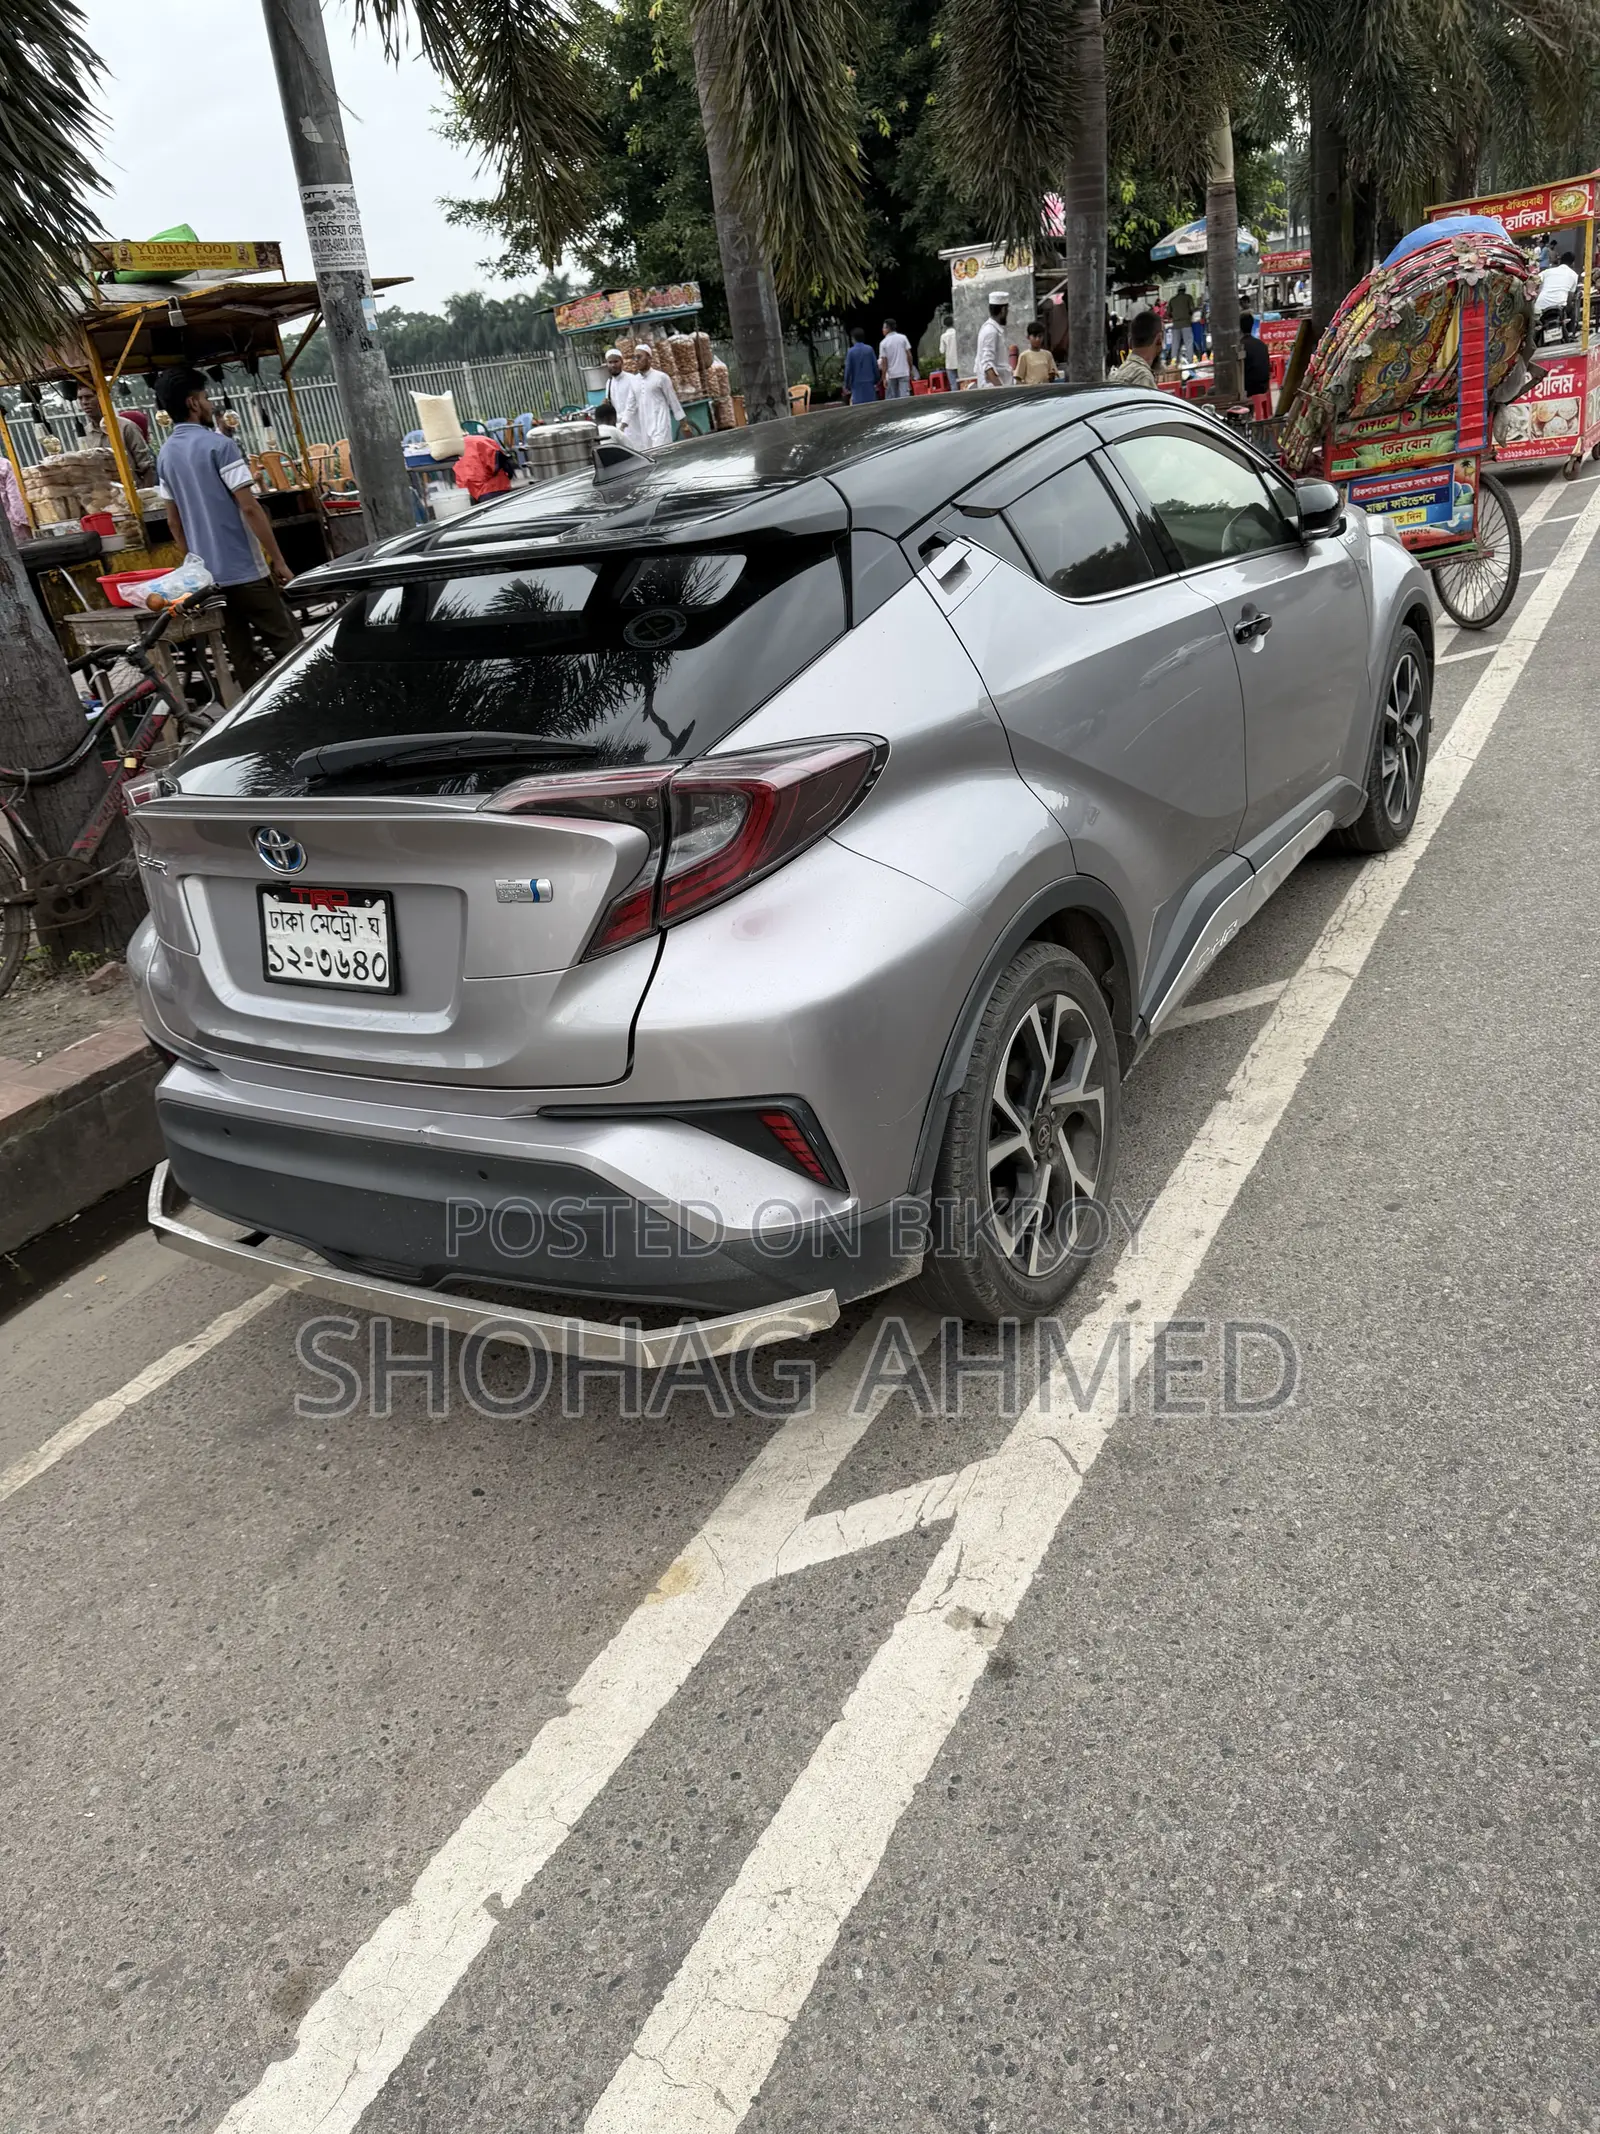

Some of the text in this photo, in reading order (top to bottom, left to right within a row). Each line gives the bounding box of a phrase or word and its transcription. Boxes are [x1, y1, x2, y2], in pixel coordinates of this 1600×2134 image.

[1505, 209, 1547, 231] হালিম
[135, 243, 190, 255] YUMMY
[194, 243, 232, 255] FOOD
[1534, 368, 1575, 399] হালিম
[1381, 438, 1433, 456] তিন বোন
[1406, 510, 1422, 523] দিন
[291, 887, 349, 912] TRD
[268, 909, 305, 932] ঢাকা
[269, 944, 387, 982] ১২-৩৬৪০
